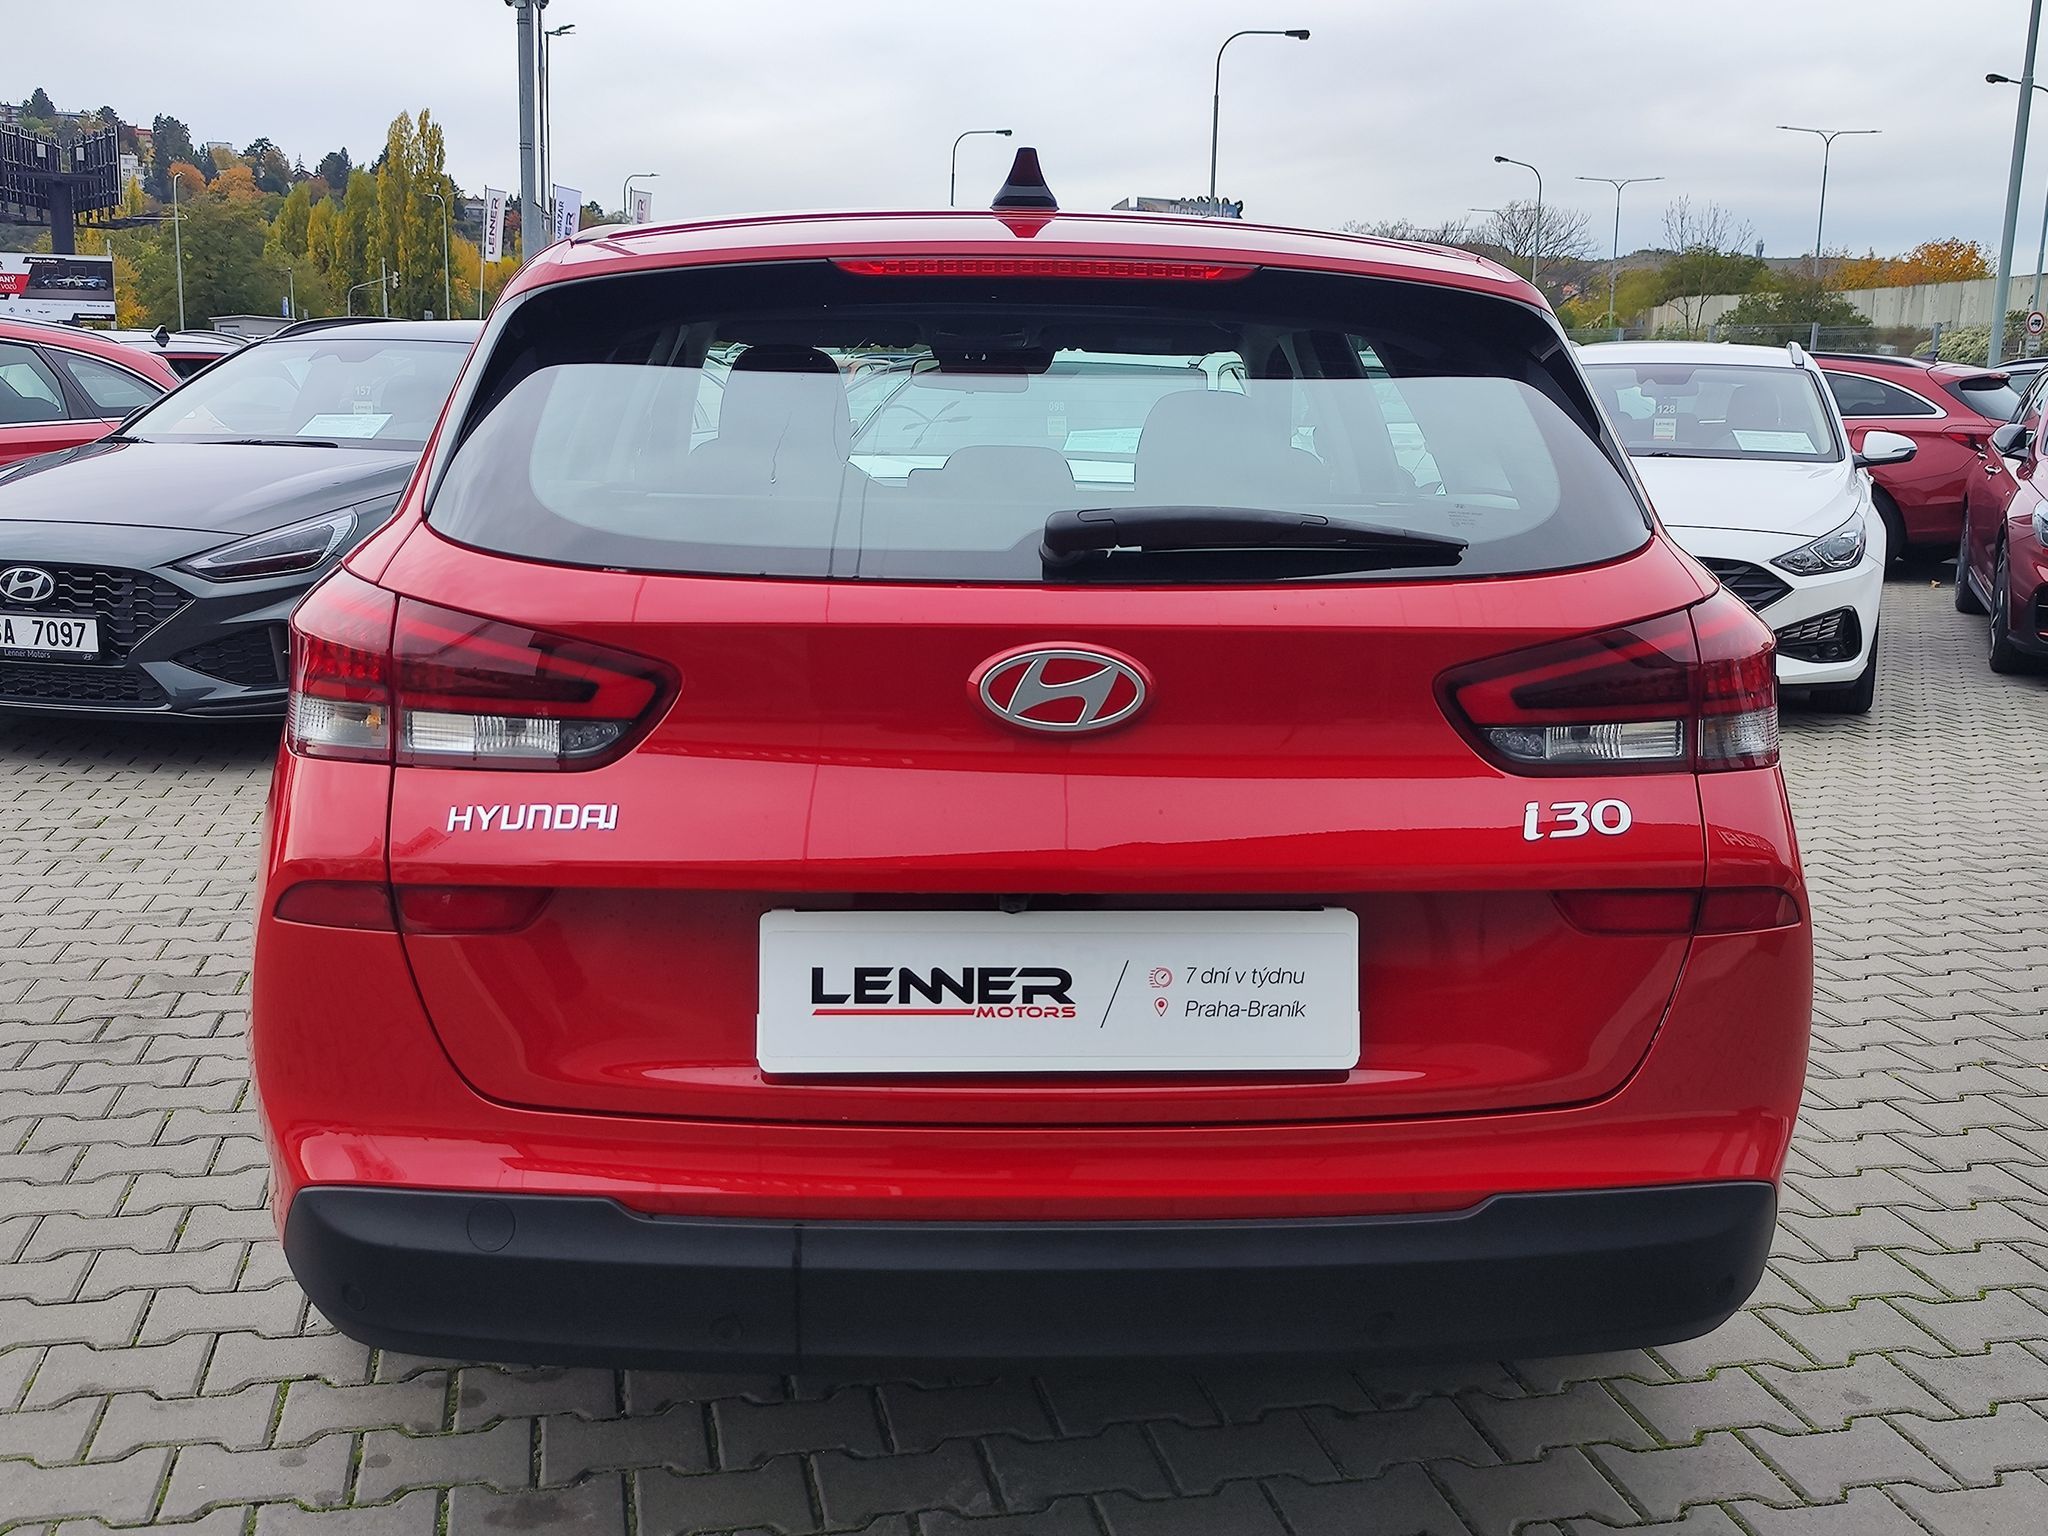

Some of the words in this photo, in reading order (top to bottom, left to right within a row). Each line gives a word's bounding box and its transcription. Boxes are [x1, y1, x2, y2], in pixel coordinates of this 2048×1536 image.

[488, 197, 500, 255] LENNER
[565, 212, 576, 238] ER
[355, 385, 371, 396] 157
[1657, 405, 1676, 414] 128
[0, 618, 15, 644] A
[32, 620, 86, 648] 7097
[4, 649, 26, 657] Lenner
[27, 650, 51, 659] Motors
[446, 803, 619, 832] HYUNDAI
[1522, 797, 1633, 842] i30
[811, 967, 1076, 1004] LENNER
[1186, 966, 1197, 984] 7
[1201, 966, 1232, 984] dní
[1235, 971, 1246, 984] v
[1251, 966, 1305, 988] týdnu
[976, 1006, 1077, 1018] MOTORS
[1184, 1000, 1306, 1018] Praha-Braník
